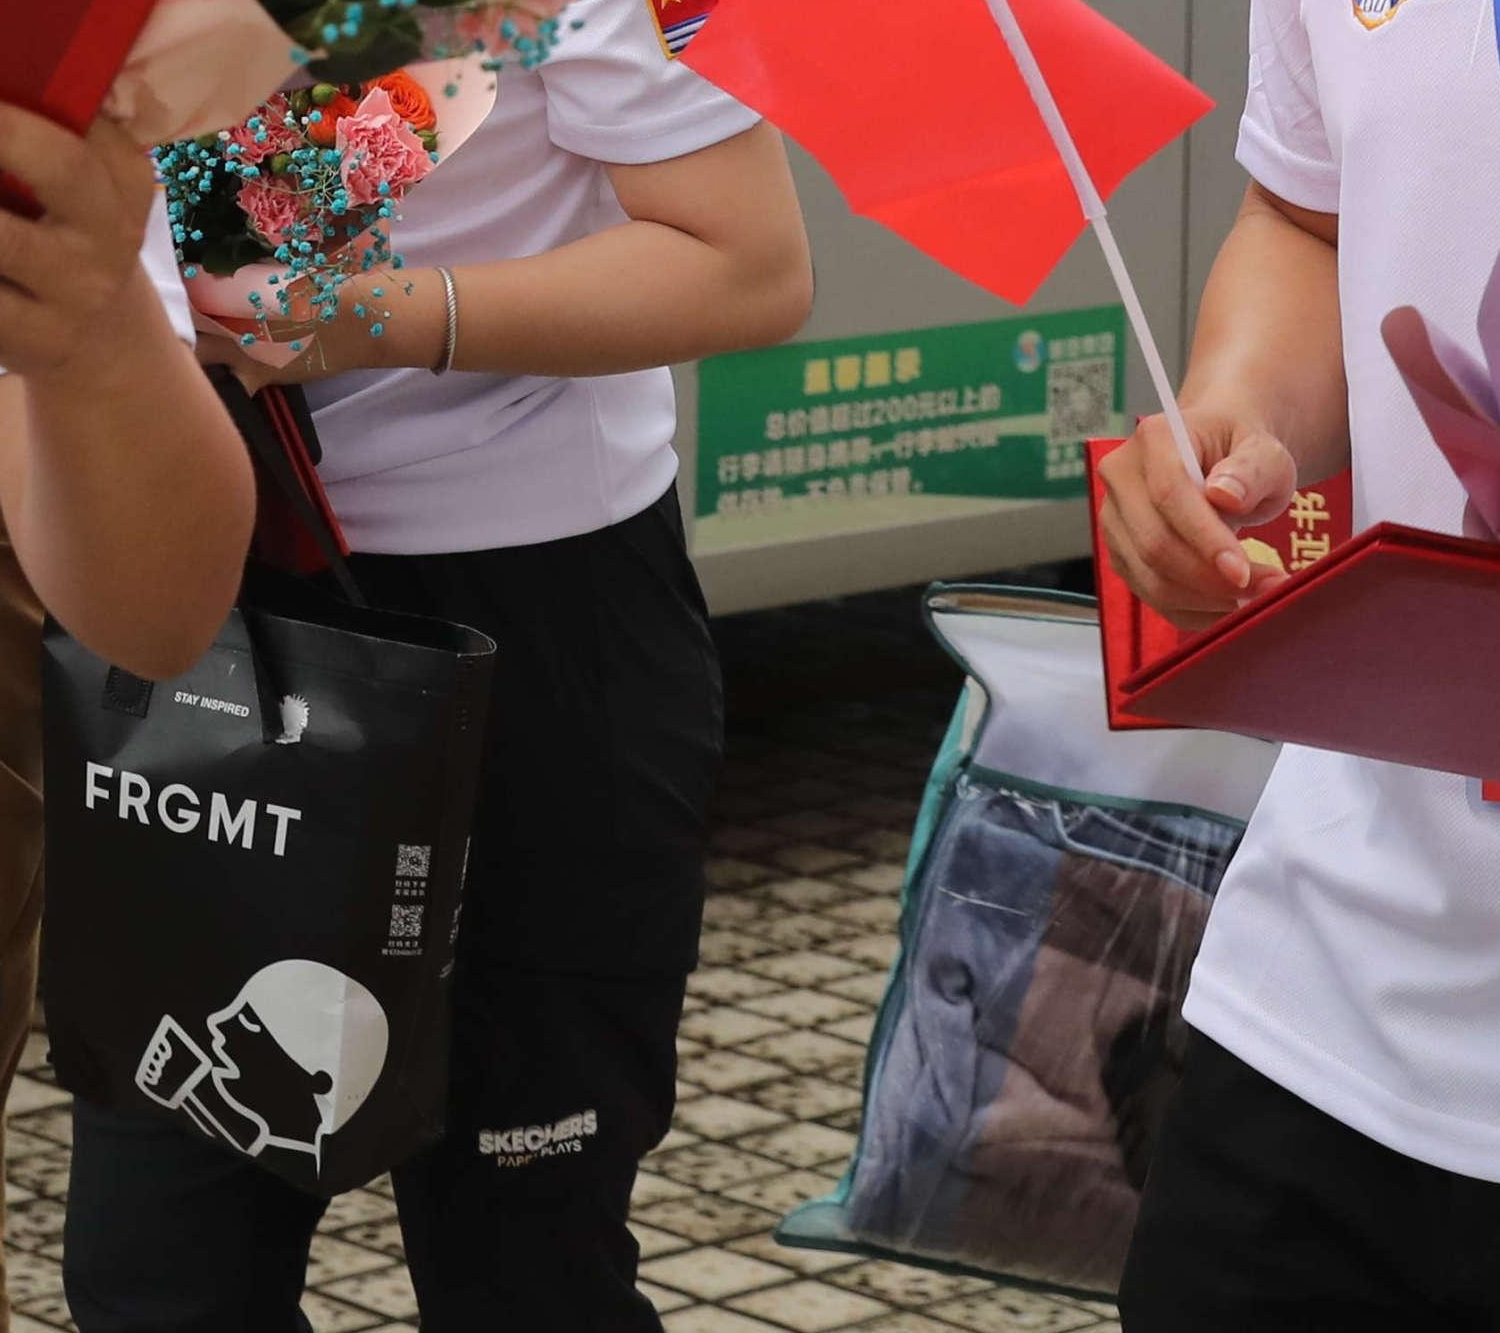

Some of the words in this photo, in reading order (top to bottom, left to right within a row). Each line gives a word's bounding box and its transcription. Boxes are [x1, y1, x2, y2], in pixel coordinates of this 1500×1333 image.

[174, 691, 201, 706] STAY
[200, 696, 250, 718] INSPIRED
[85, 761, 302, 857] FRGMT
[479, 1109, 598, 1154] SKECHERS
